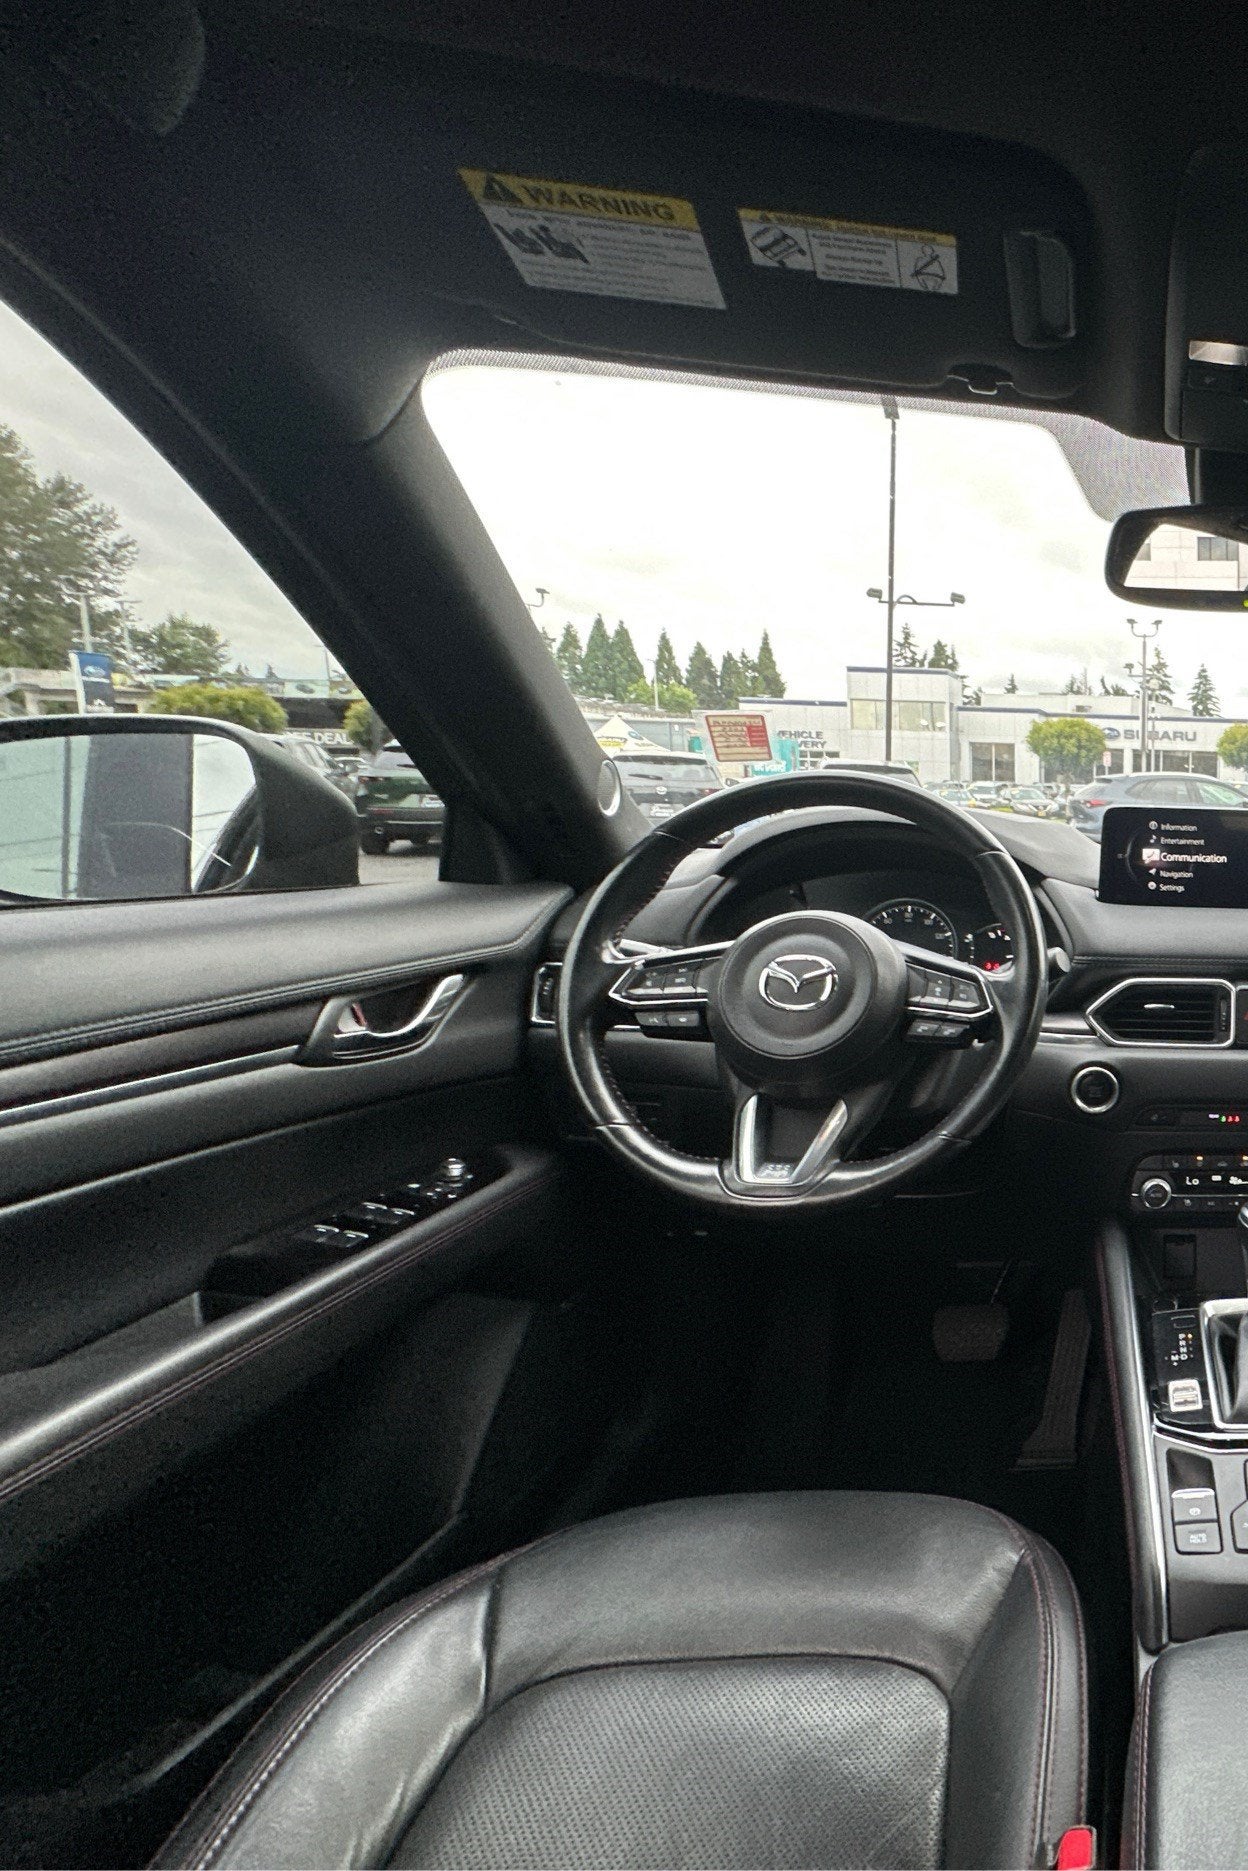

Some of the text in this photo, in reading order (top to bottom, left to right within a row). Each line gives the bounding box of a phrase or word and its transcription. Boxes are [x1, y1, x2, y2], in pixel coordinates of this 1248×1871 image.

[524, 184, 675, 221] WARNING
[1161, 823, 1198, 832] Information
[1161, 837, 1205, 846] Entertainment
[1160, 852, 1228, 863] Communication
[1160, 870, 1194, 880] Navigation
[1159, 883, 1185, 893] Settings
